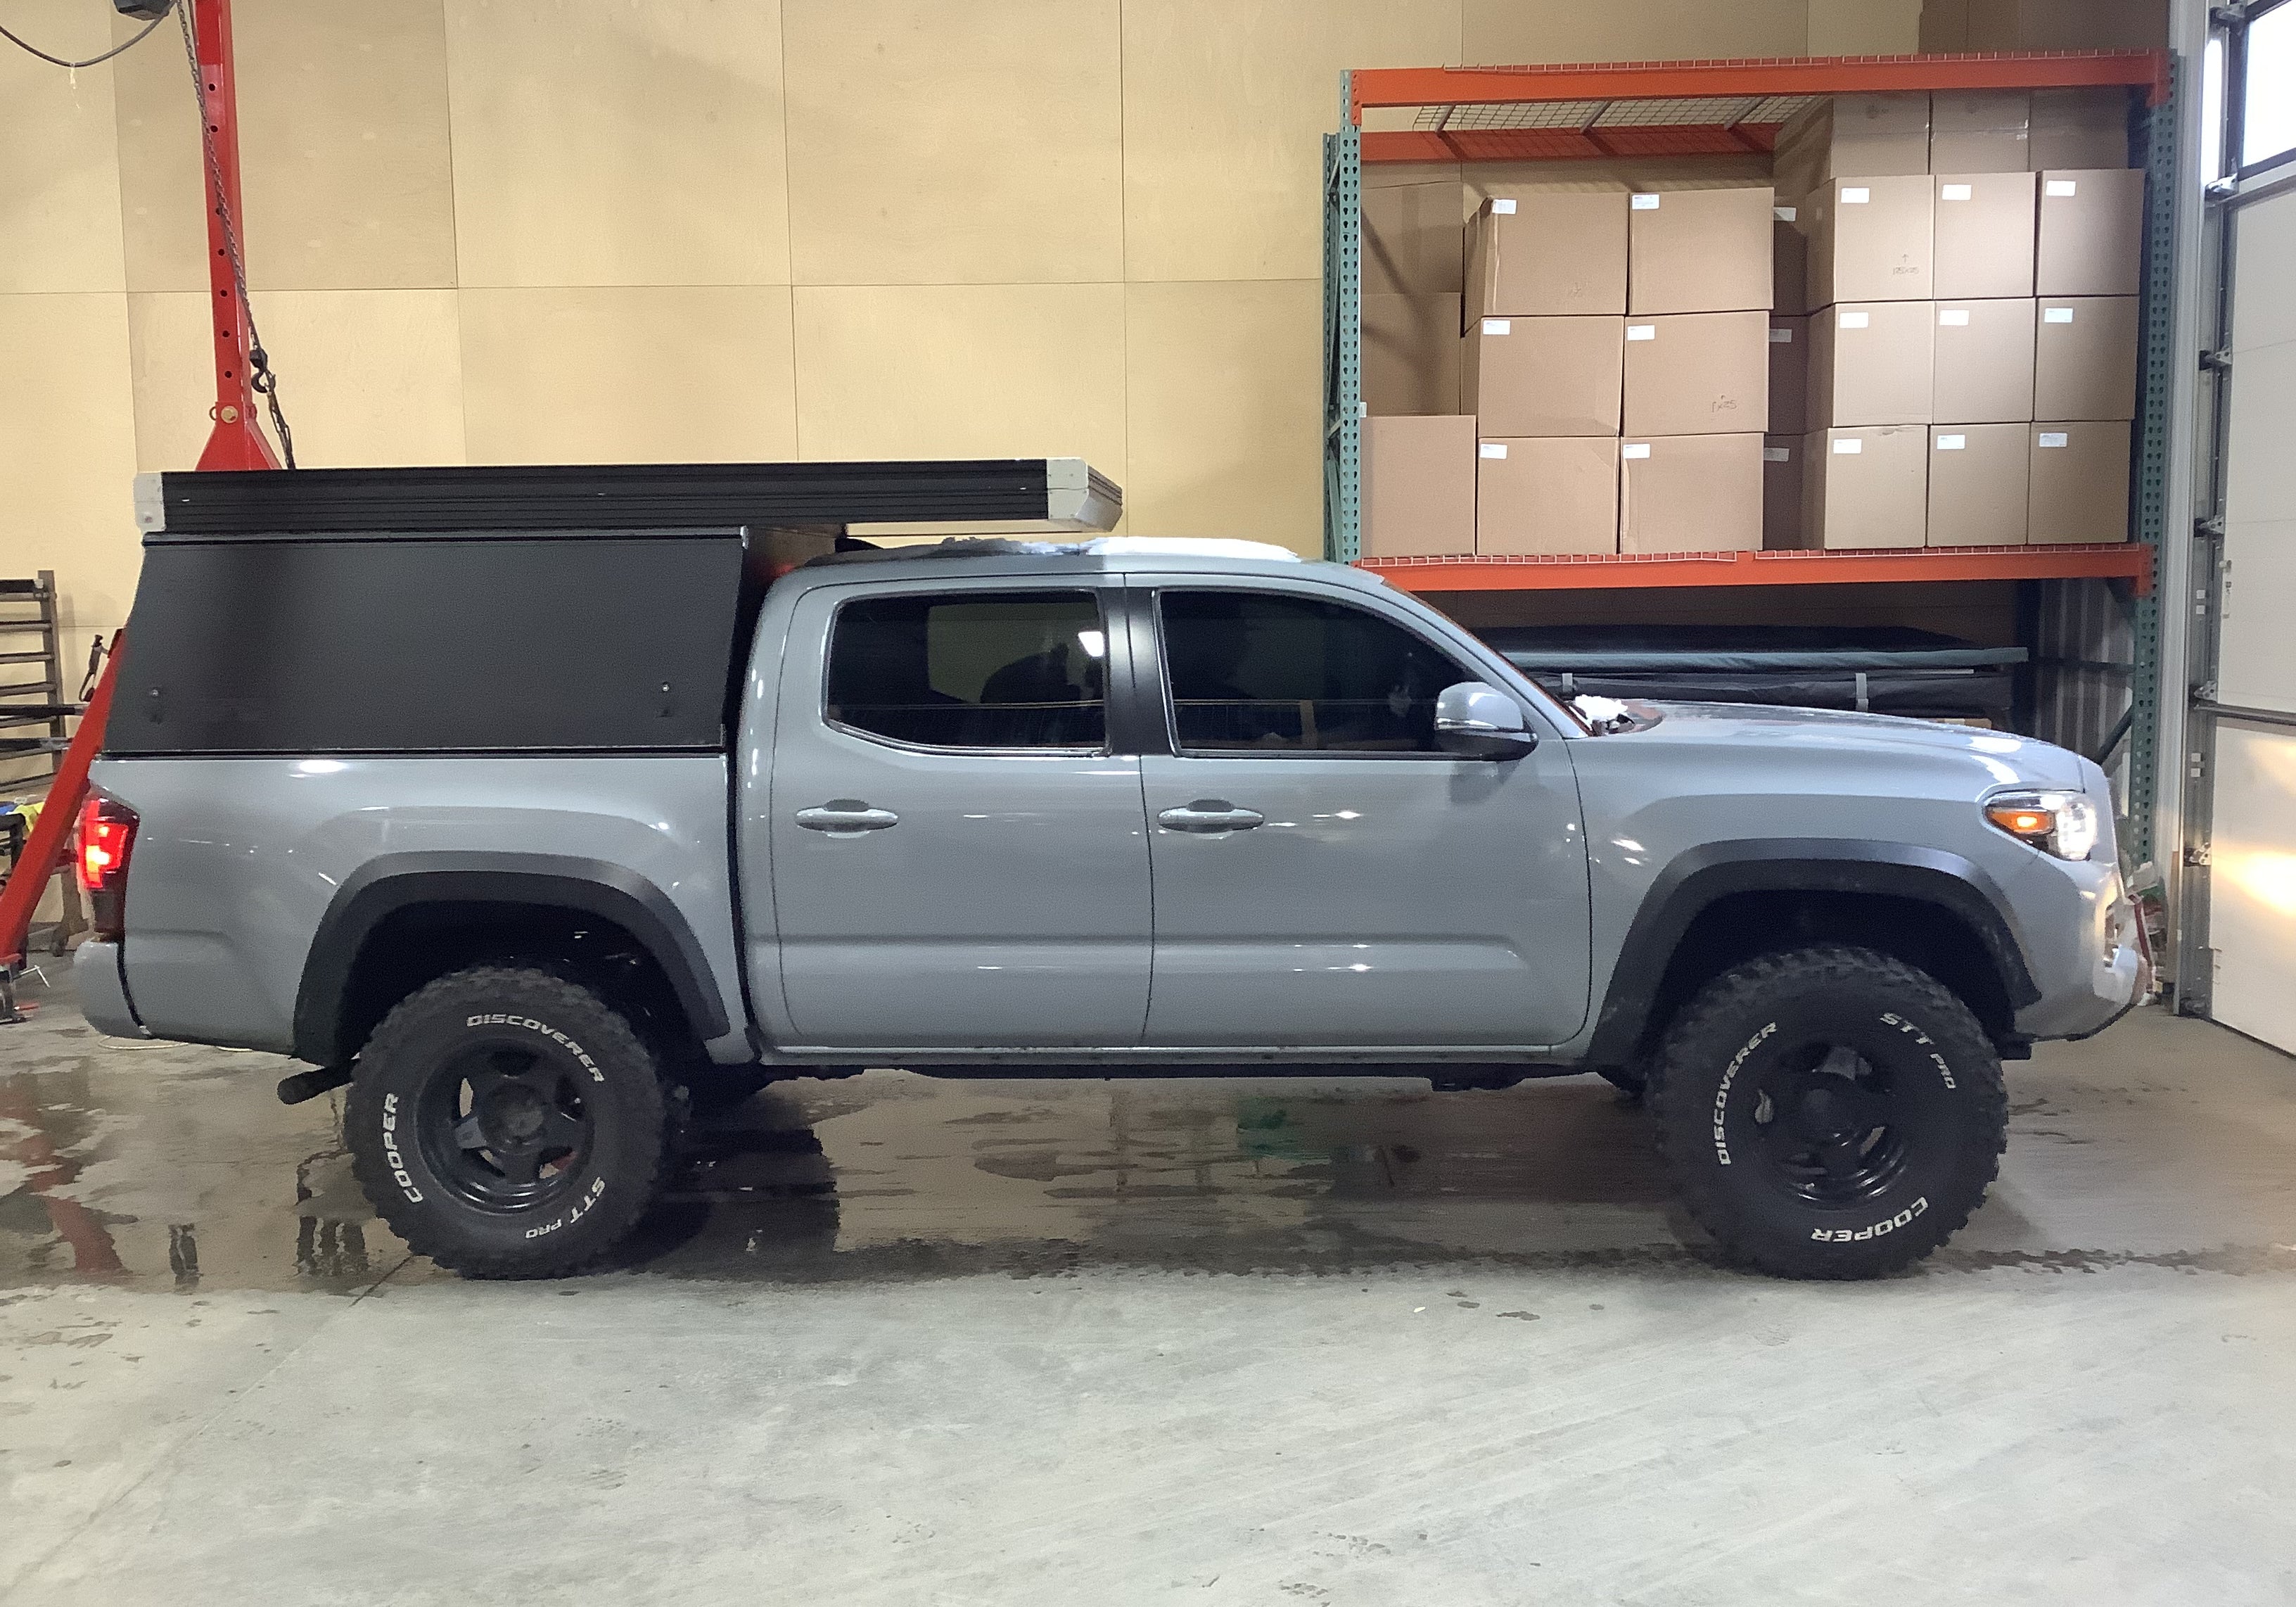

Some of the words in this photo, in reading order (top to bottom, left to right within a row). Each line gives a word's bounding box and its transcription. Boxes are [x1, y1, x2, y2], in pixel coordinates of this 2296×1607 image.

[466, 1013, 605, 1082] DISCOVERER
[1879, 1012, 1934, 1046] STT
[1930, 1053, 1956, 1089] PRO
[1713, 1022, 1778, 1165] DISCOVERER
[382, 1093, 423, 1203] COOPER
[525, 1218, 562, 1239] PRO
[570, 1176, 606, 1224] STT
[1810, 1196, 1930, 1243] COOPER
